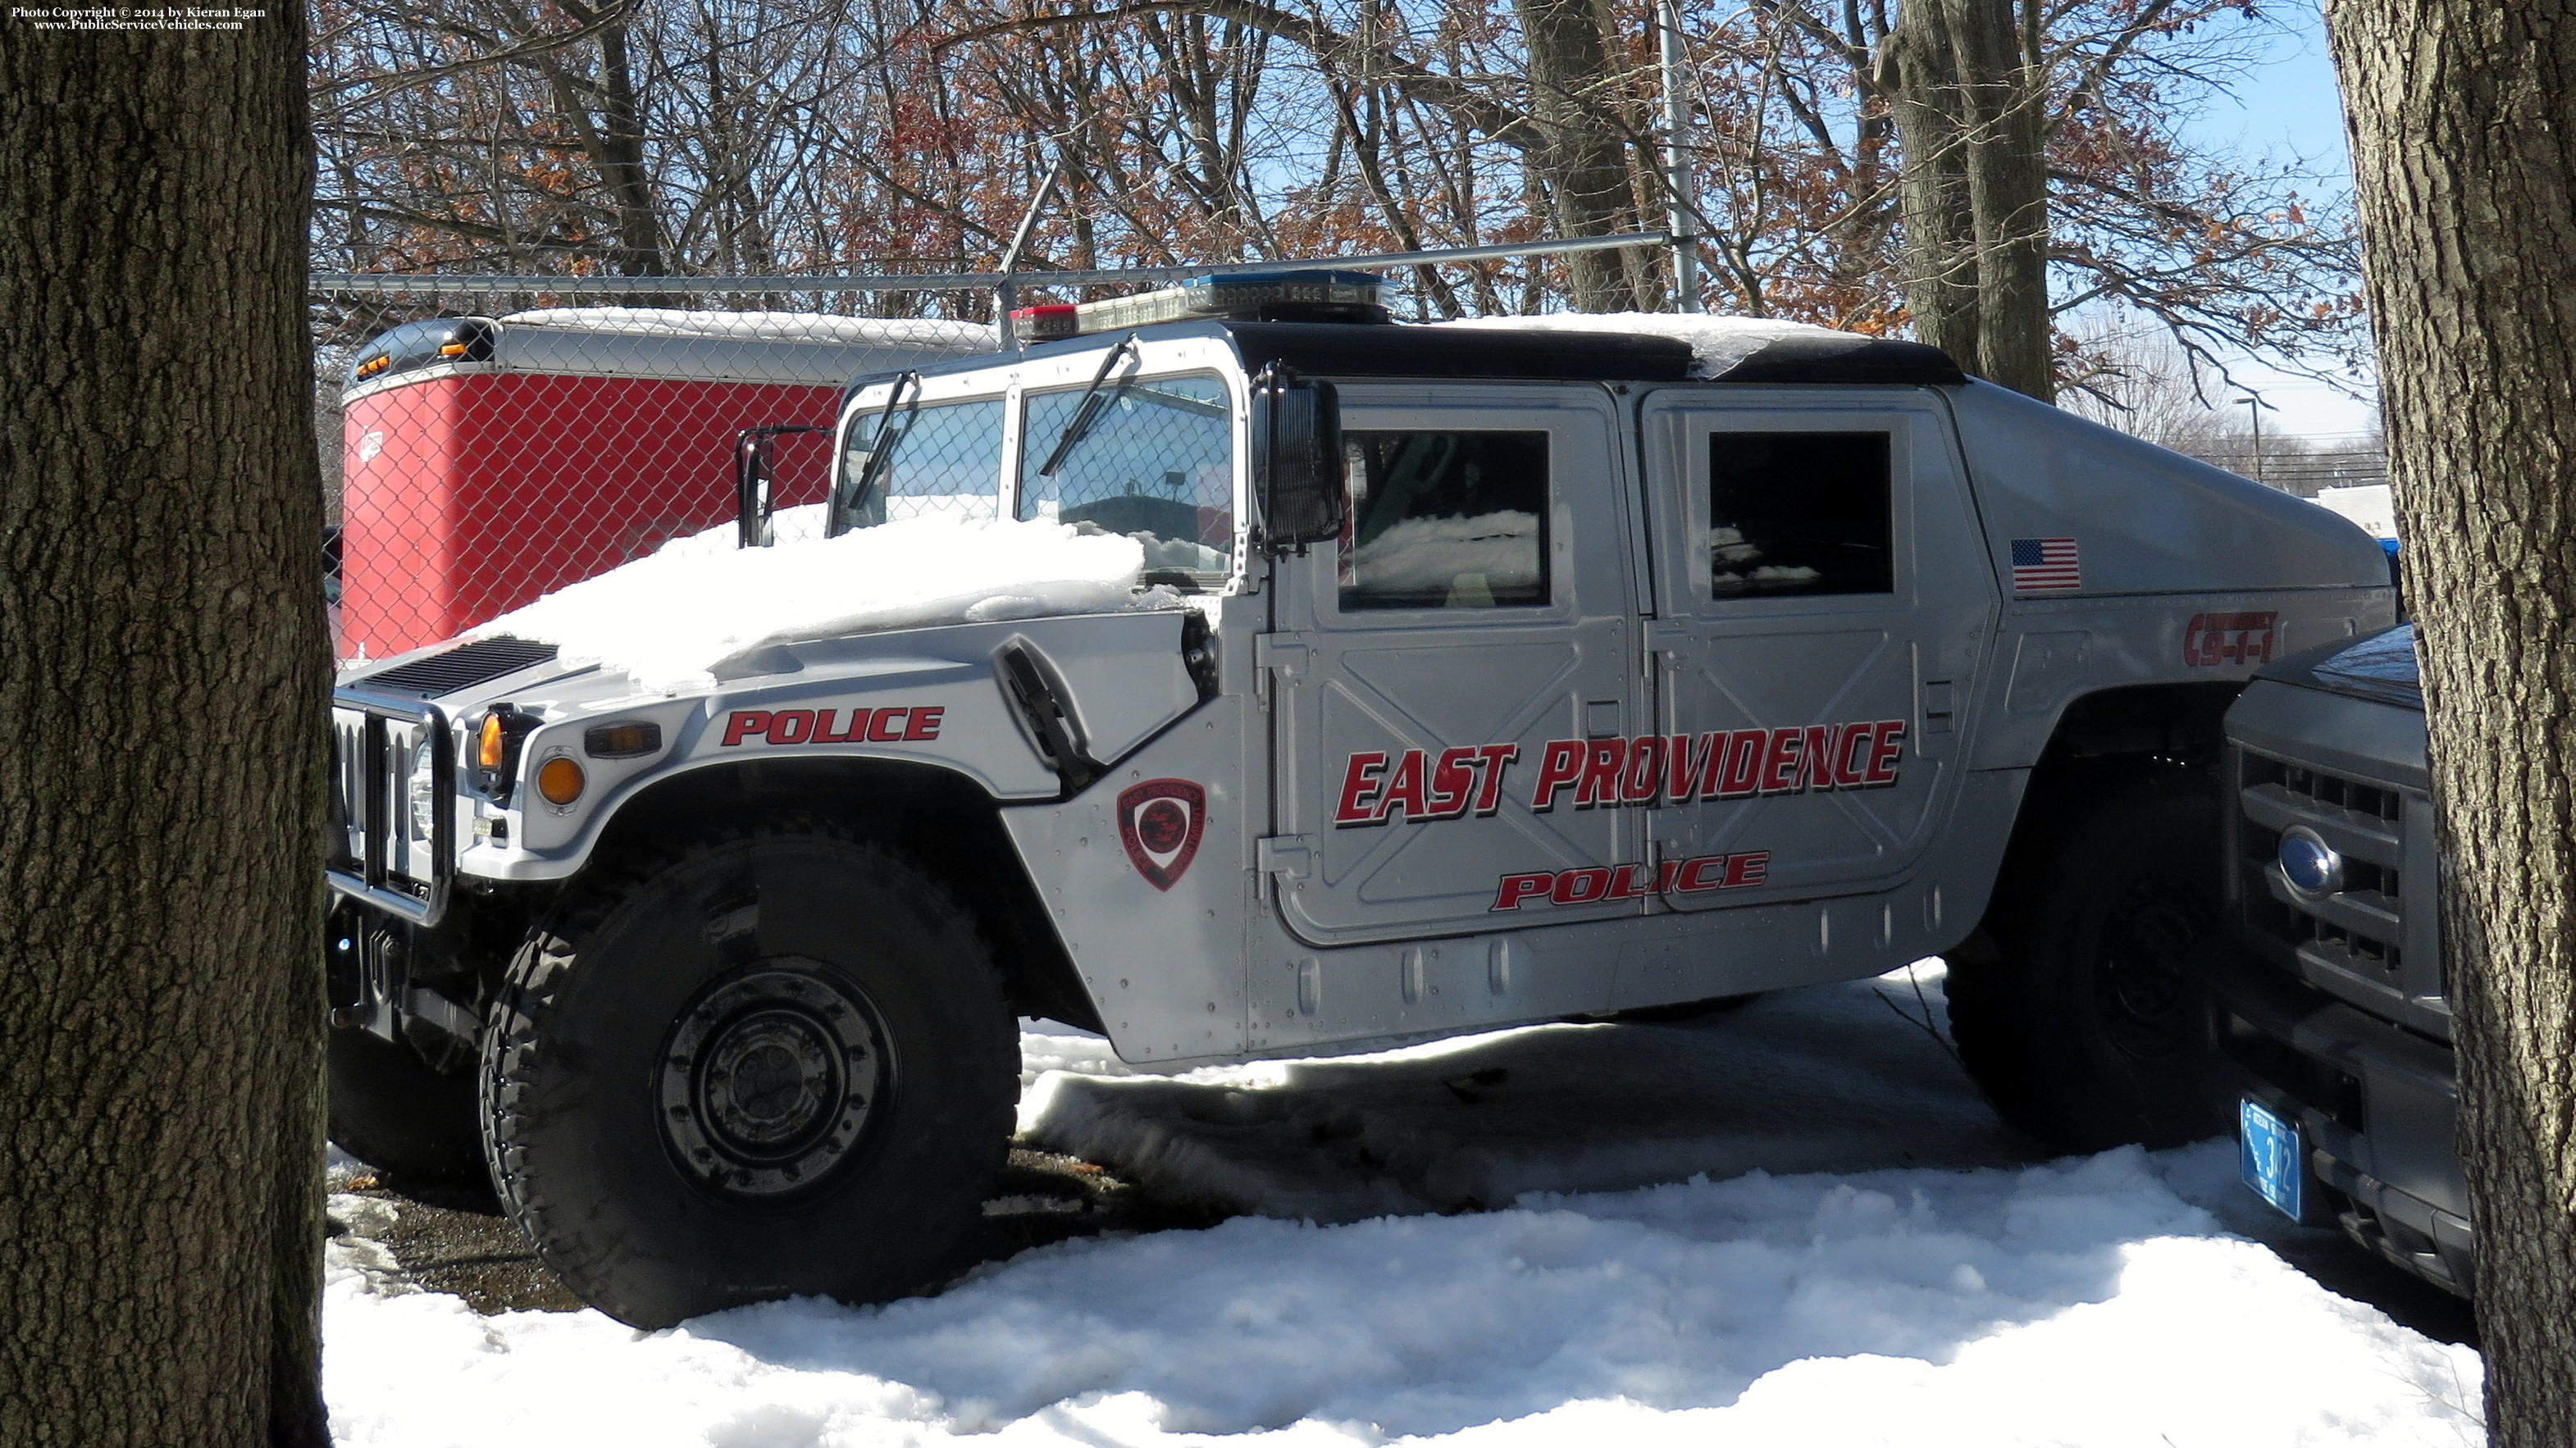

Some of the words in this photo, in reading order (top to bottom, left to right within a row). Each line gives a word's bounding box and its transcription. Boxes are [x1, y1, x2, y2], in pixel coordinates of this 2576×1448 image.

[720, 706, 945, 746] POLICE
[1334, 742, 1521, 830] EAST
[1530, 718, 1908, 811] PROVIDENCE
[1488, 849, 1771, 912] POLICE
